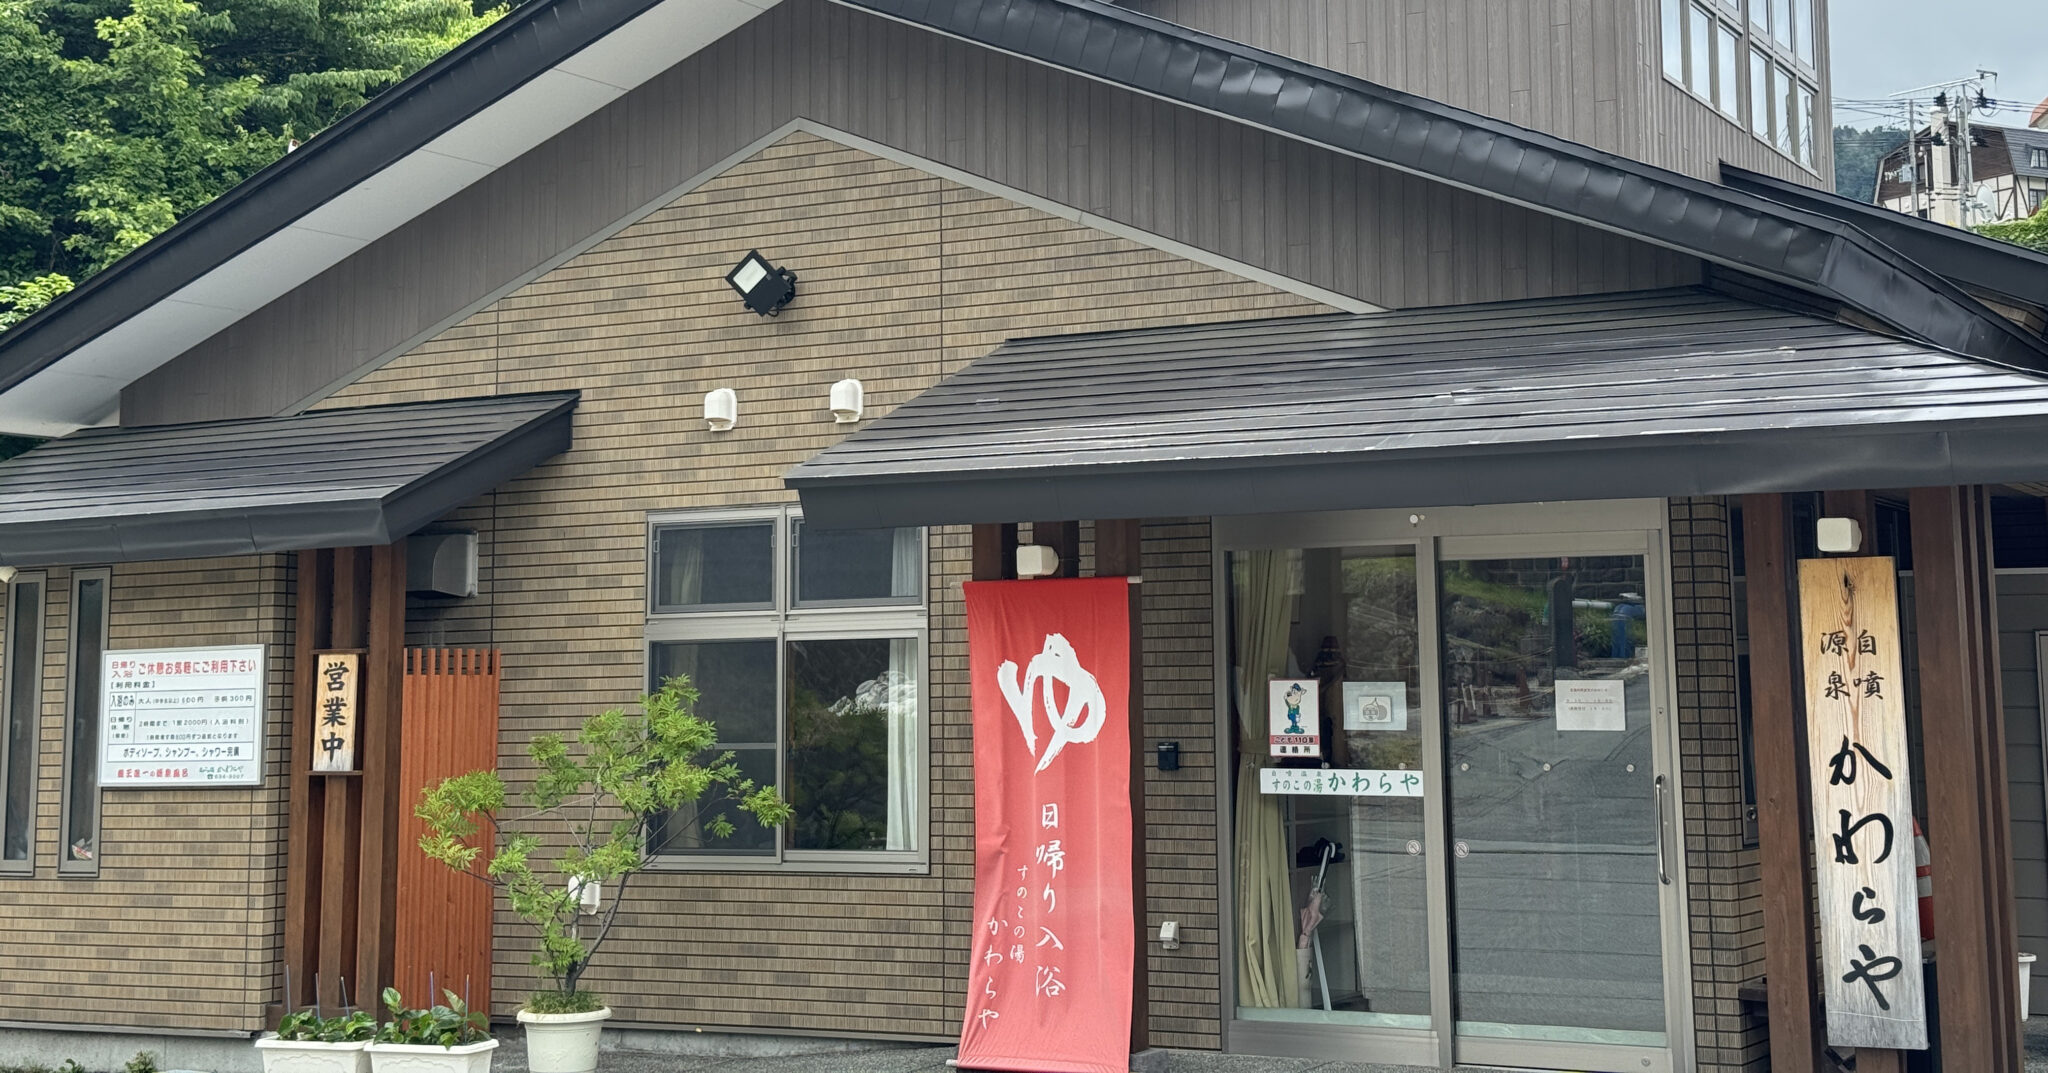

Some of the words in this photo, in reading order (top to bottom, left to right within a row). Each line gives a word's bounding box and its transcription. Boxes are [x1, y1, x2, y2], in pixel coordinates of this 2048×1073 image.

[320, 661, 350, 763] 営業中
[997, 632, 1107, 776] ゆ
[1820, 630, 1852, 700] 源泉
[1851, 629, 1885, 701] 自噴
[1272, 778, 1323, 794] すのこの湯
[1328, 772, 1420, 795] かわらや
[1279, 745, 1312, 754] 連絡所
[1009, 863, 1030, 965] すのこの湯
[1035, 802, 1067, 999] 日帰り入浴
[1828, 733, 1903, 1011] かわらや
[976, 915, 1009, 1030] かわらや
